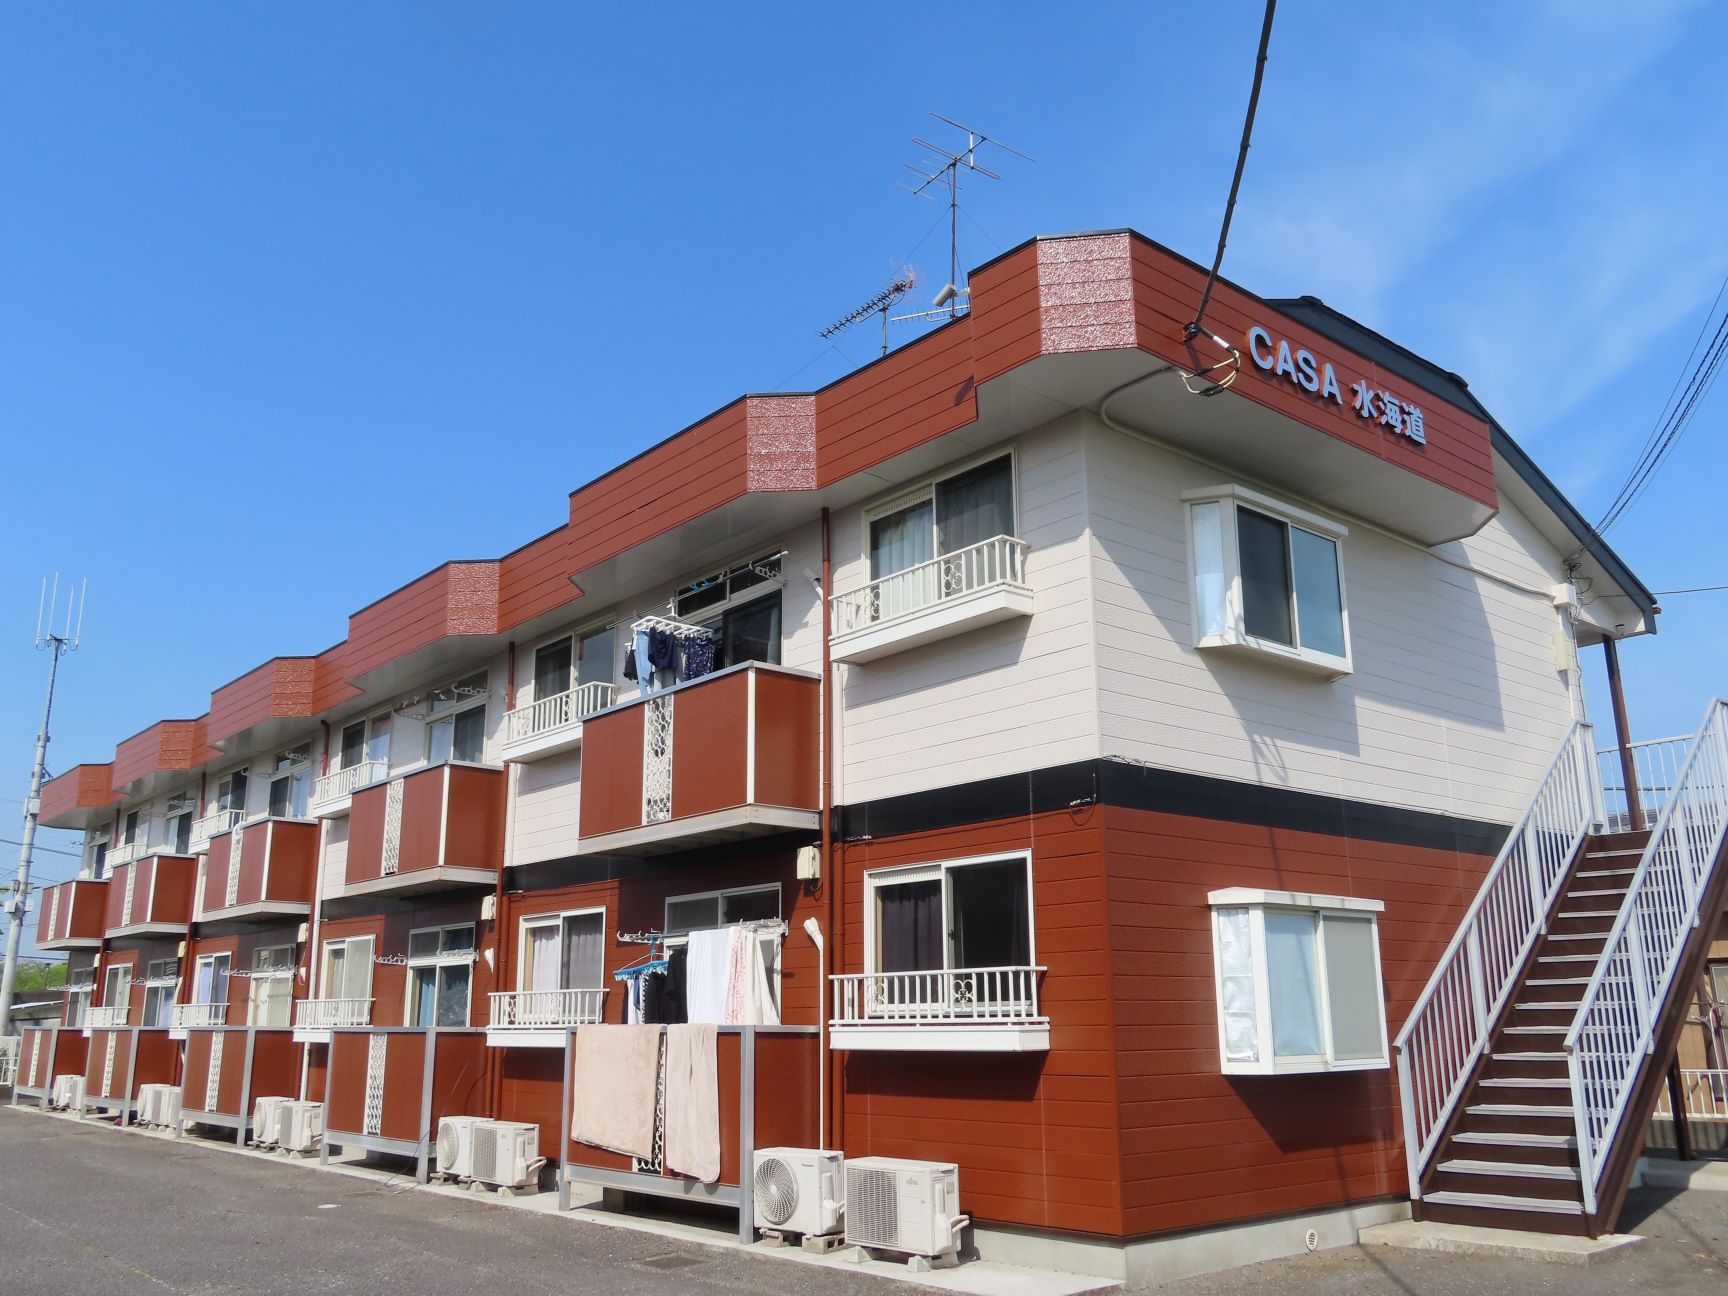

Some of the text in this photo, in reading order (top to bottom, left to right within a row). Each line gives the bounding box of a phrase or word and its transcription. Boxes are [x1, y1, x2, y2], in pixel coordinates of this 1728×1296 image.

[1249, 326, 1427, 445] CASA 水海道
